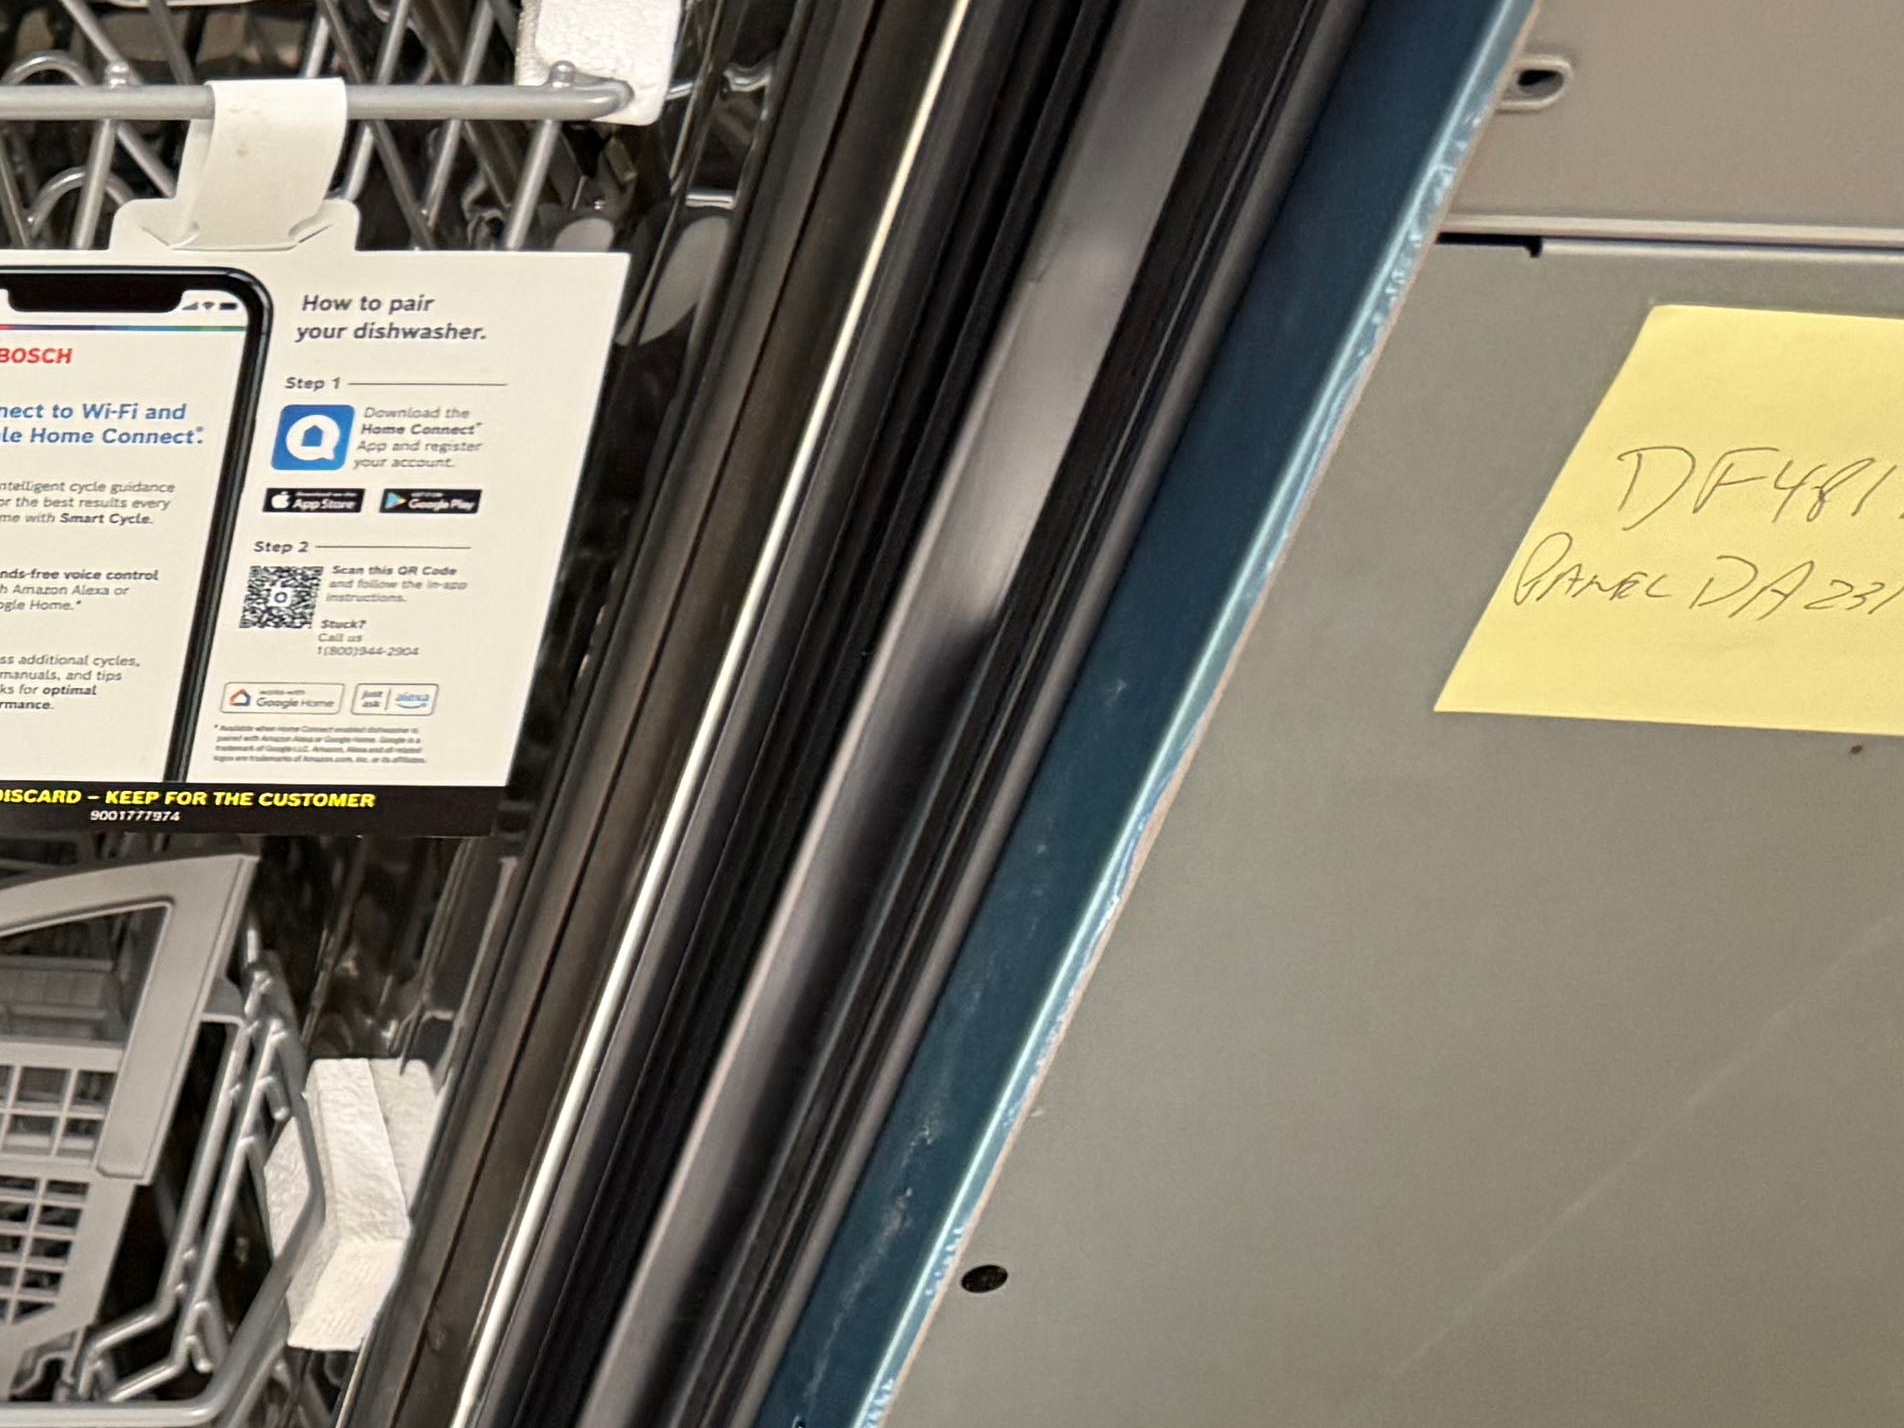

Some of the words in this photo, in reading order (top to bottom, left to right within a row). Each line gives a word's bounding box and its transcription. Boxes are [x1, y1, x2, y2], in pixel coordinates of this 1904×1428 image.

[301, 294, 353, 312] How
[359, 295, 382, 312] to
[388, 293, 436, 315] pair
[293, 325, 347, 343] your
[353, 321, 487, 340] dishwasher.
[284, 377, 326, 392] Step
[331, 377, 341, 389] 1
[52, 403, 74, 419] to
[81, 403, 139, 420] Wi-Fi
[145, 403, 187, 420] and
[364, 406, 441, 419] Download
[445, 407, 471, 420] the
[29, 428, 94, 444] Home
[360, 423, 405, 436] Home
[356, 440, 387, 453] App
[391, 440, 421, 453] and
[424, 441, 483, 454] register
[352, 457, 387, 470] your
[69, 480, 107, 495] cycle
[110, 481, 176, 495] guidance
[1617, 445, 1904, 532] DF481
[15, 496, 40, 508] the
[43, 496, 74, 508] best
[78, 496, 128, 509] results
[131, 498, 172, 511] every
[292, 498, 319, 511] App
[320, 498, 358, 510] Store
[25, 512, 56, 523] with
[60, 512, 105, 524] Smart
[108, 513, 154, 526] Cycle.
[253, 541, 293, 555] Step
[297, 541, 309, 553] 2
[63, 569, 102, 581] voice
[105, 569, 160, 581] control
[332, 565, 365, 576] Scan
[368, 565, 393, 576] this
[397, 566, 418, 577] QR
[421, 566, 457, 577] Code
[11, 584, 68, 596] Amazon
[71, 584, 110, 596] Alexa
[114, 586, 131, 596] or
[328, 579, 354, 590] and
[357, 579, 398, 590] follow
[401, 579, 423, 590] the
[320, 619, 367, 630] Stuck?
[318, 632, 344, 643] Call
[347, 633, 363, 643] us
[18, 654, 90, 666] additional
[65, 670, 92, 681] and
[95, 670, 122, 683] tips
[17, 683, 41, 695] for
[41, 684, 98, 698] optimal
[256, 697, 299, 710] Google
[301, 698, 335, 708] Home
[105, 790, 160, 806] KEEP
[164, 791, 207, 806] FOR
[214, 791, 254, 807] THE
[258, 791, 377, 808] CUSTOMER
[89, 809, 181, 822] 9001777974
